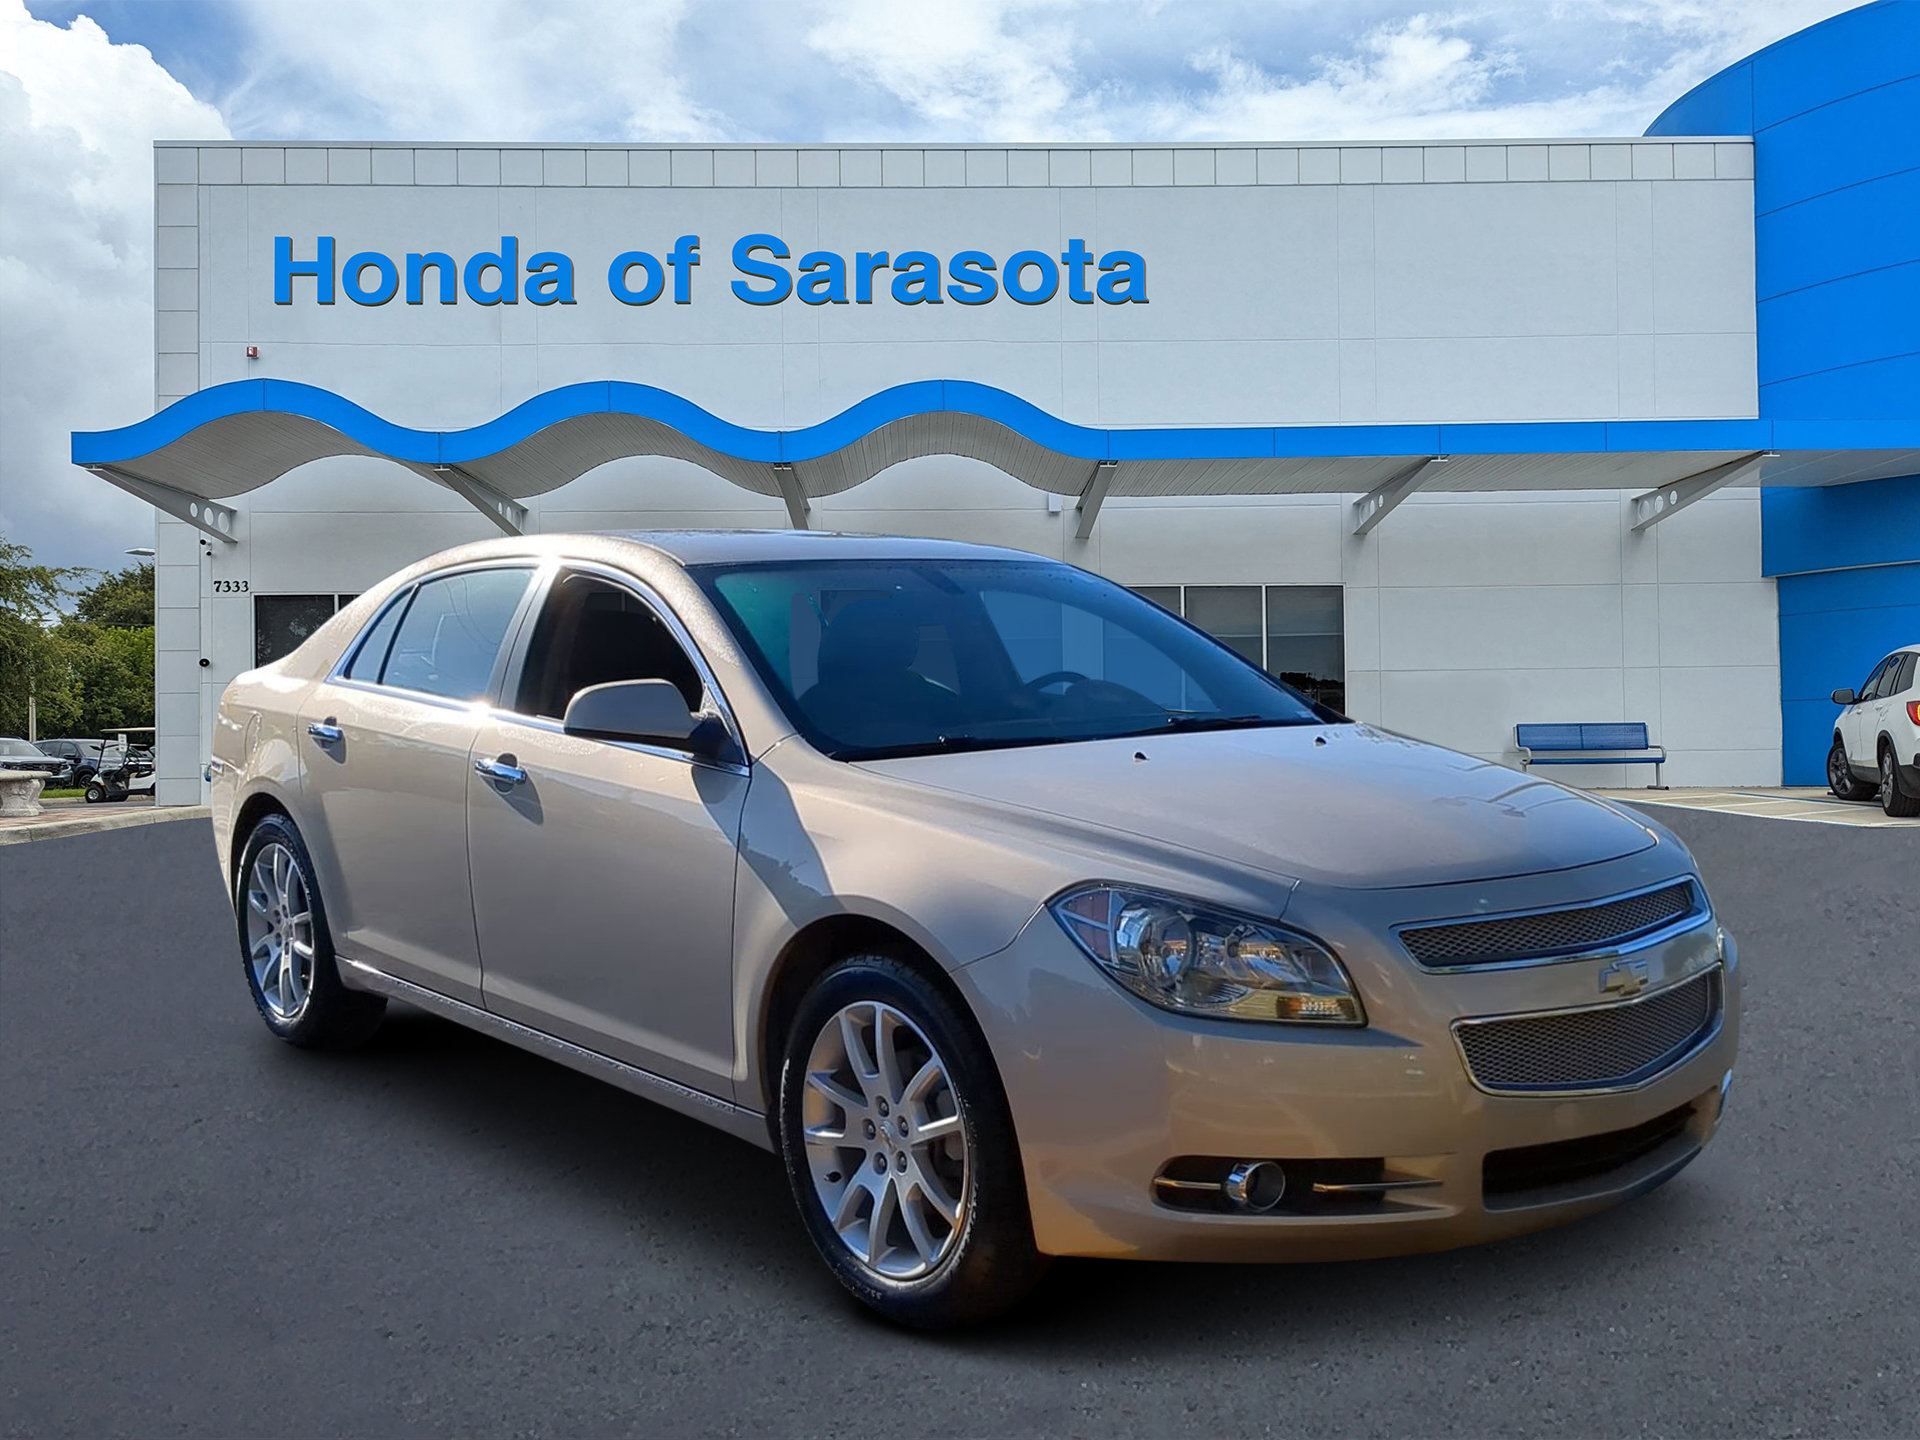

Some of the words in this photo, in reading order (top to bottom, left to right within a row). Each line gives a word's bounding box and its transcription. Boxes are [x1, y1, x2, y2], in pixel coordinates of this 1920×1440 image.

[274, 235, 577, 306] Honda
[608, 234, 700, 306] of
[730, 233, 1150, 306] Sarasota
[213, 580, 249, 593] 7333
